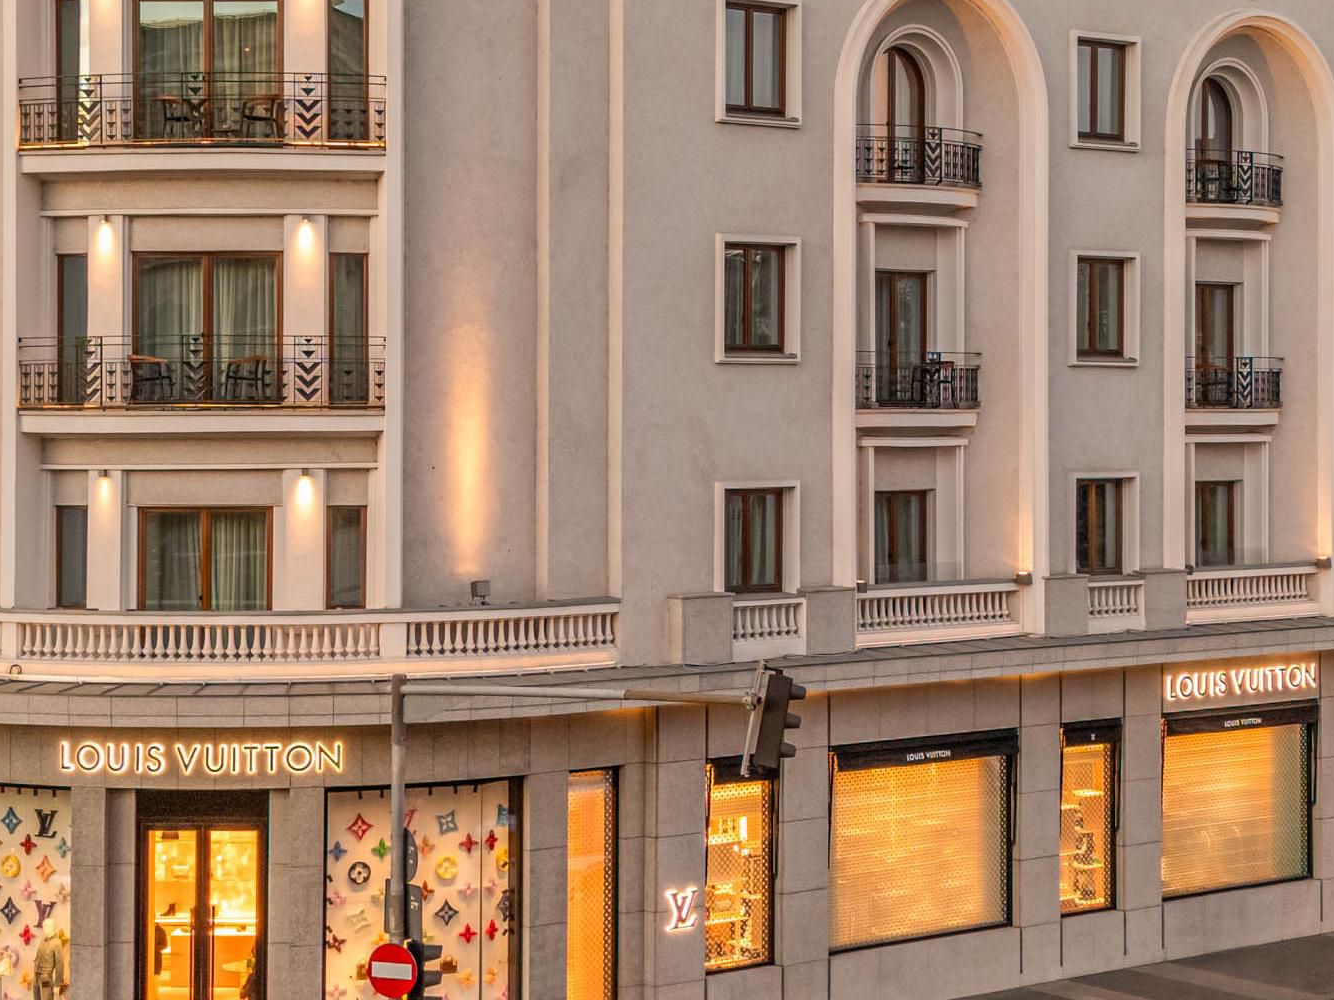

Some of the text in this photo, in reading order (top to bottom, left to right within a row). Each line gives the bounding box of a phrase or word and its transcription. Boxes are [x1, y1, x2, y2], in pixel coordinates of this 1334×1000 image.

[1166, 663, 1317, 700] LOUIS VUITTON
[60, 740, 343, 774] LOUIS VUITTON
[907, 750, 951, 761] LOUIS VUITTON
